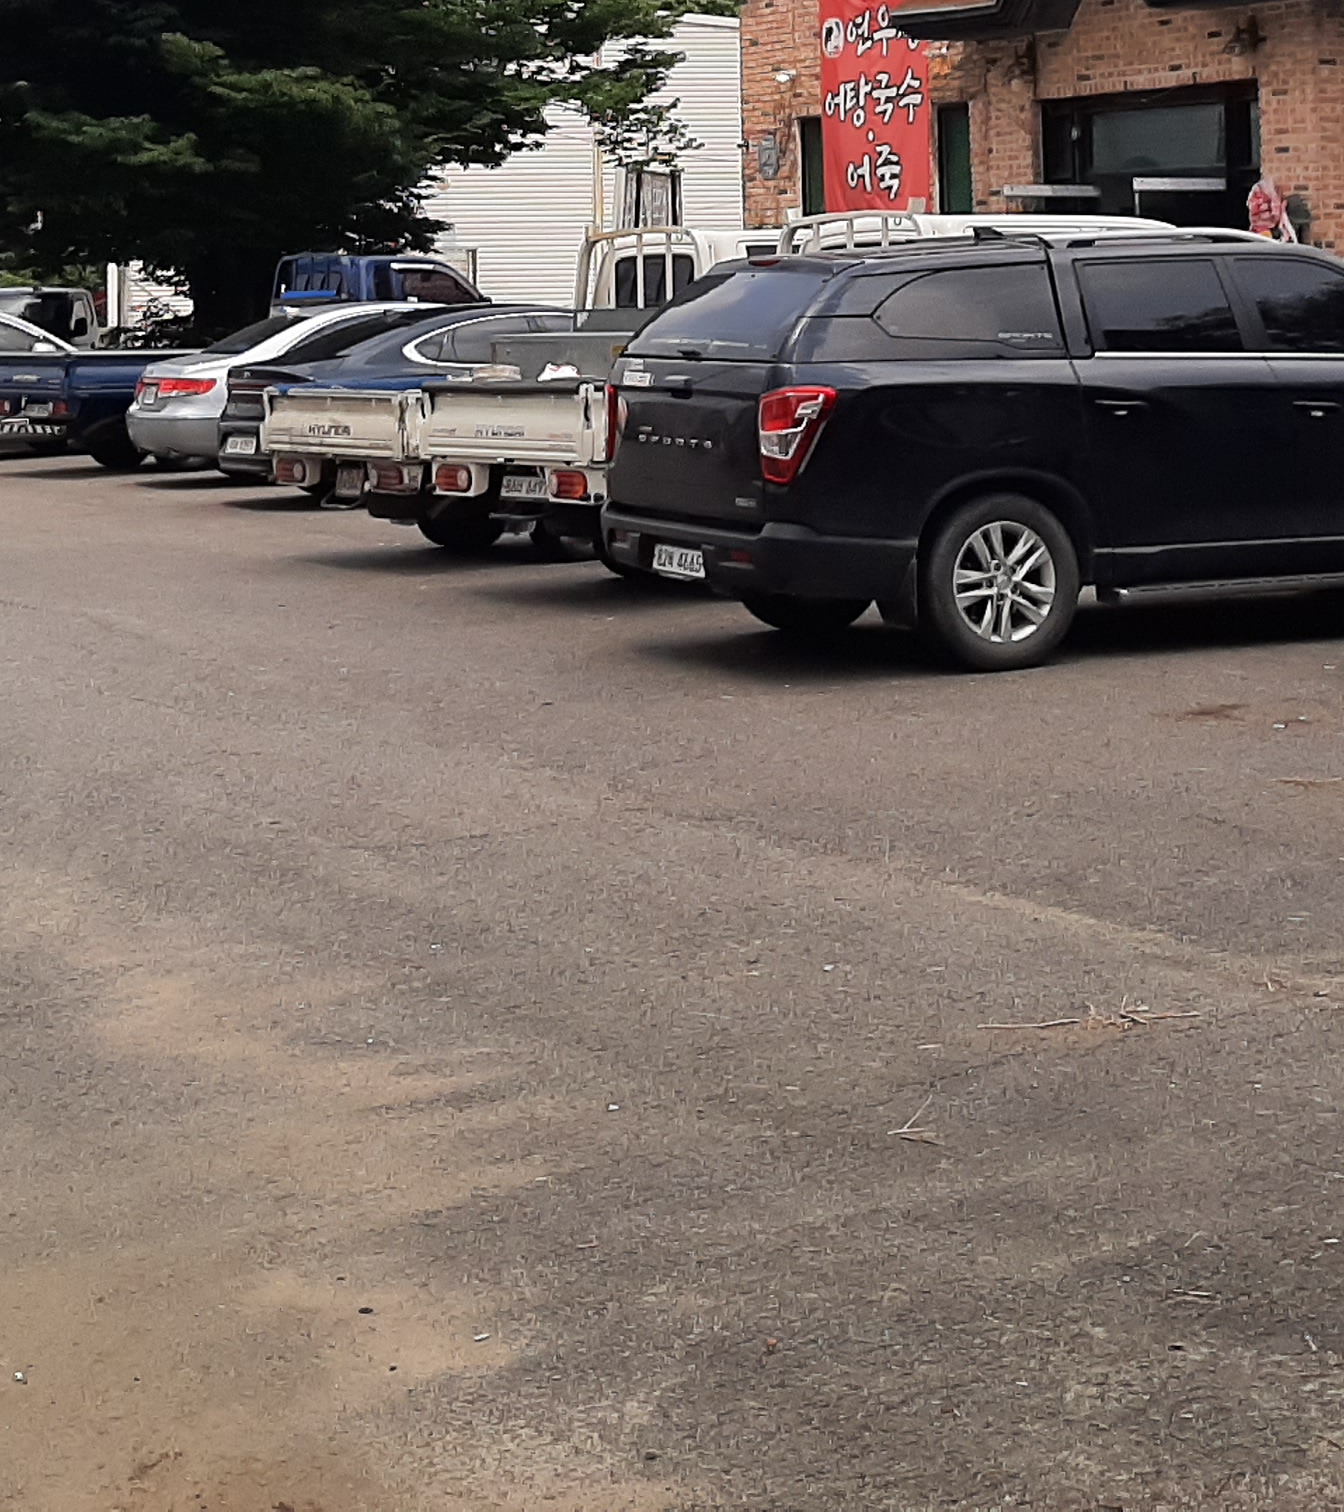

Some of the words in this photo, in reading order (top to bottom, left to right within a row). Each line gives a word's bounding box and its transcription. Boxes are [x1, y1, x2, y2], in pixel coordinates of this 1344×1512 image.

[845, 2, 921, 57] 연우
[824, 67, 924, 128] 어탕국수
[846, 143, 903, 201] 어죽
